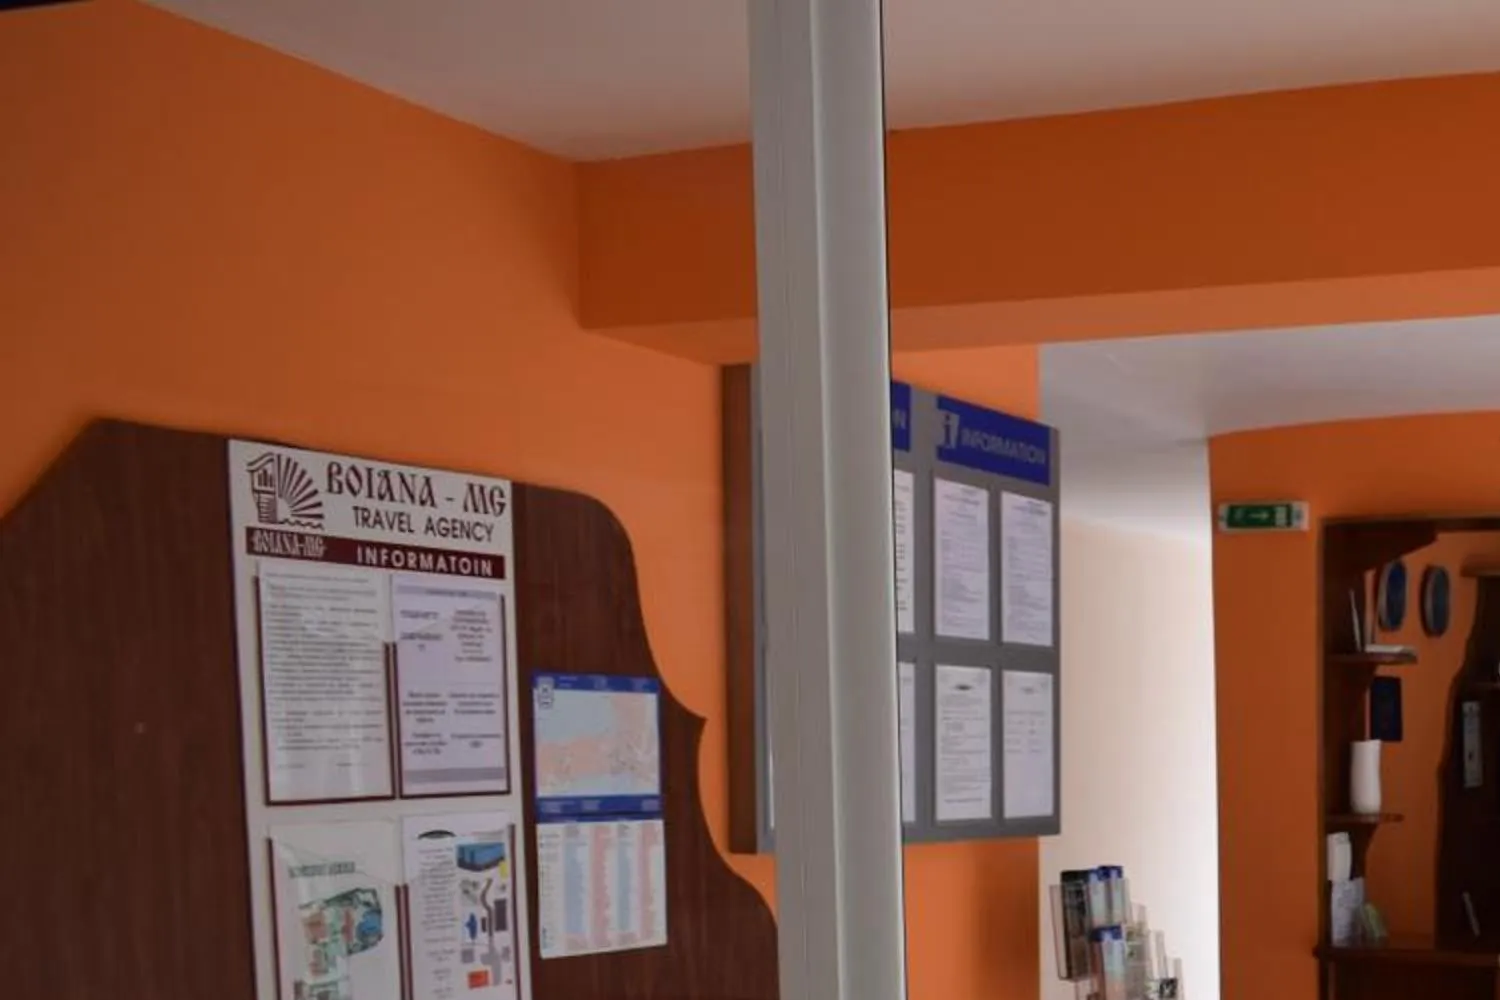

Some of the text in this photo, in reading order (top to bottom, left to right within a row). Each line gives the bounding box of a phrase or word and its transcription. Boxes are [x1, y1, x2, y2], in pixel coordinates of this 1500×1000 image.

[962, 429, 1046, 464] INFORMATION
[326, 460, 438, 509] BOIANA
[463, 482, 507, 518] MG
[352, 505, 495, 543] TRAVEL AGENCY
[356, 546, 494, 578] INFORMATOIN
